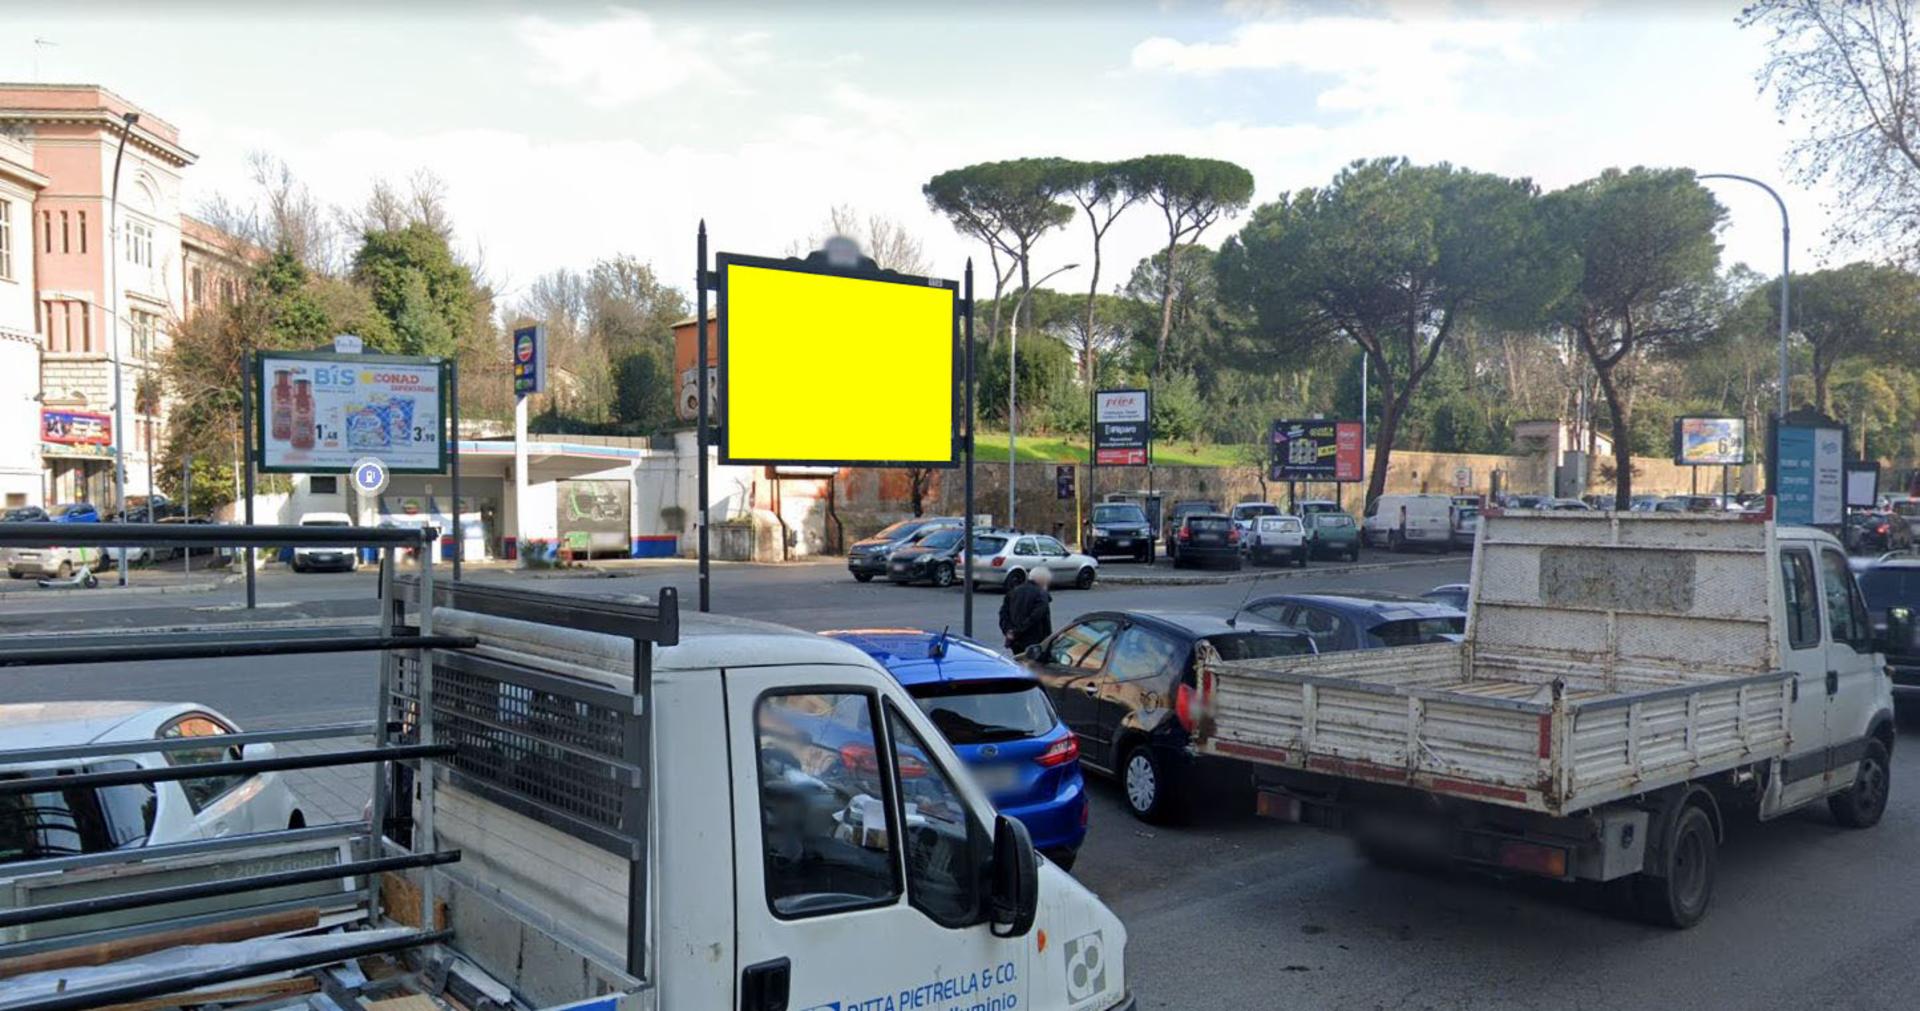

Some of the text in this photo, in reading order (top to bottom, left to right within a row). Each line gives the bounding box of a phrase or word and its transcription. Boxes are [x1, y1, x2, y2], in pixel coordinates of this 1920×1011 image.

[374, 373, 420, 385] CONAD
[847, 962, 1017, 1011] ITTA PIETRELLA & CO.
